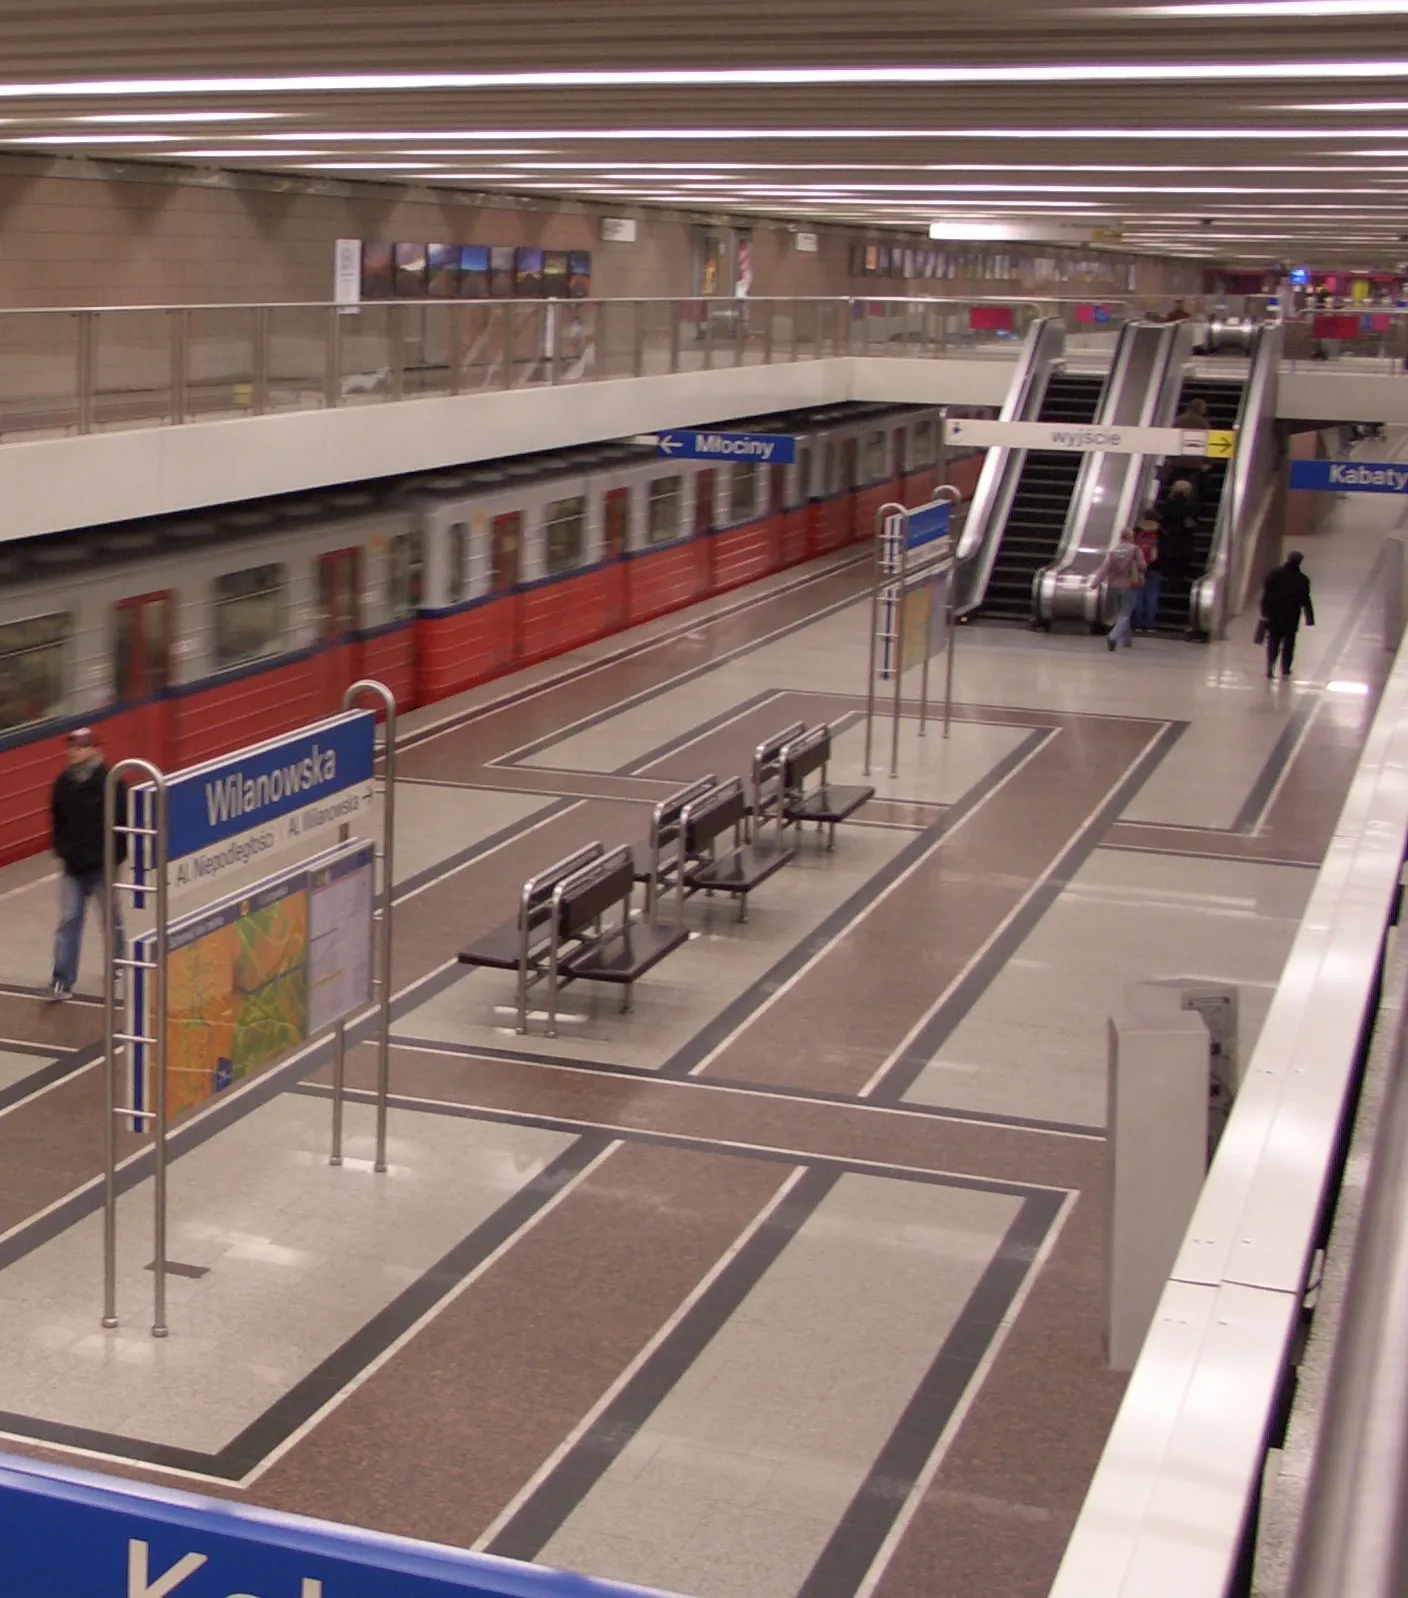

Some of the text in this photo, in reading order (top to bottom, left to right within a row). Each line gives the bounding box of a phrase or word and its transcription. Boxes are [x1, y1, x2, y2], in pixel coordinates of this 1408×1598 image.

[695, 434, 774, 460] Młociny
[1051, 427, 1122, 447] wyjście
[1329, 464, 1408, 490] Kabaty
[205, 744, 337, 826] Wilanowska
